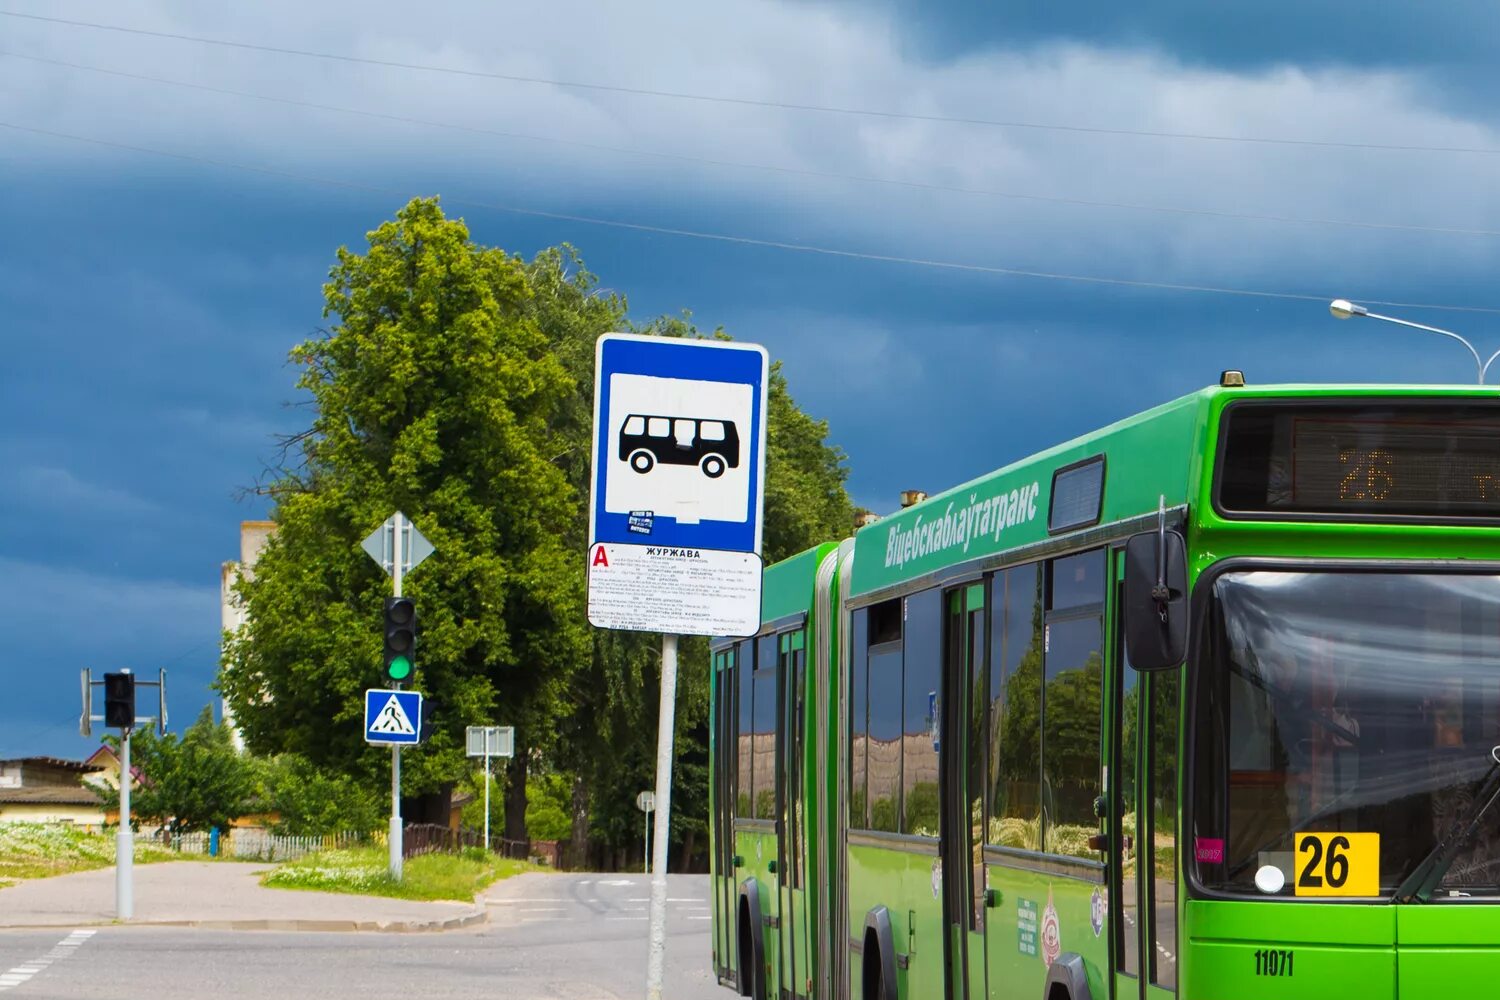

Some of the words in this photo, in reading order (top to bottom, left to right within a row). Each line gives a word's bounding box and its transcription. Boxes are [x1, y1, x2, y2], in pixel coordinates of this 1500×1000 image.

[1337, 448, 1393, 501] 26
[884, 480, 1039, 570] Віцебскаблаўтатранс
[646, 547, 701, 559] ЖУРЖАВА
[1298, 835, 1350, 888] 26
[1254, 949, 1294, 976] 11071
